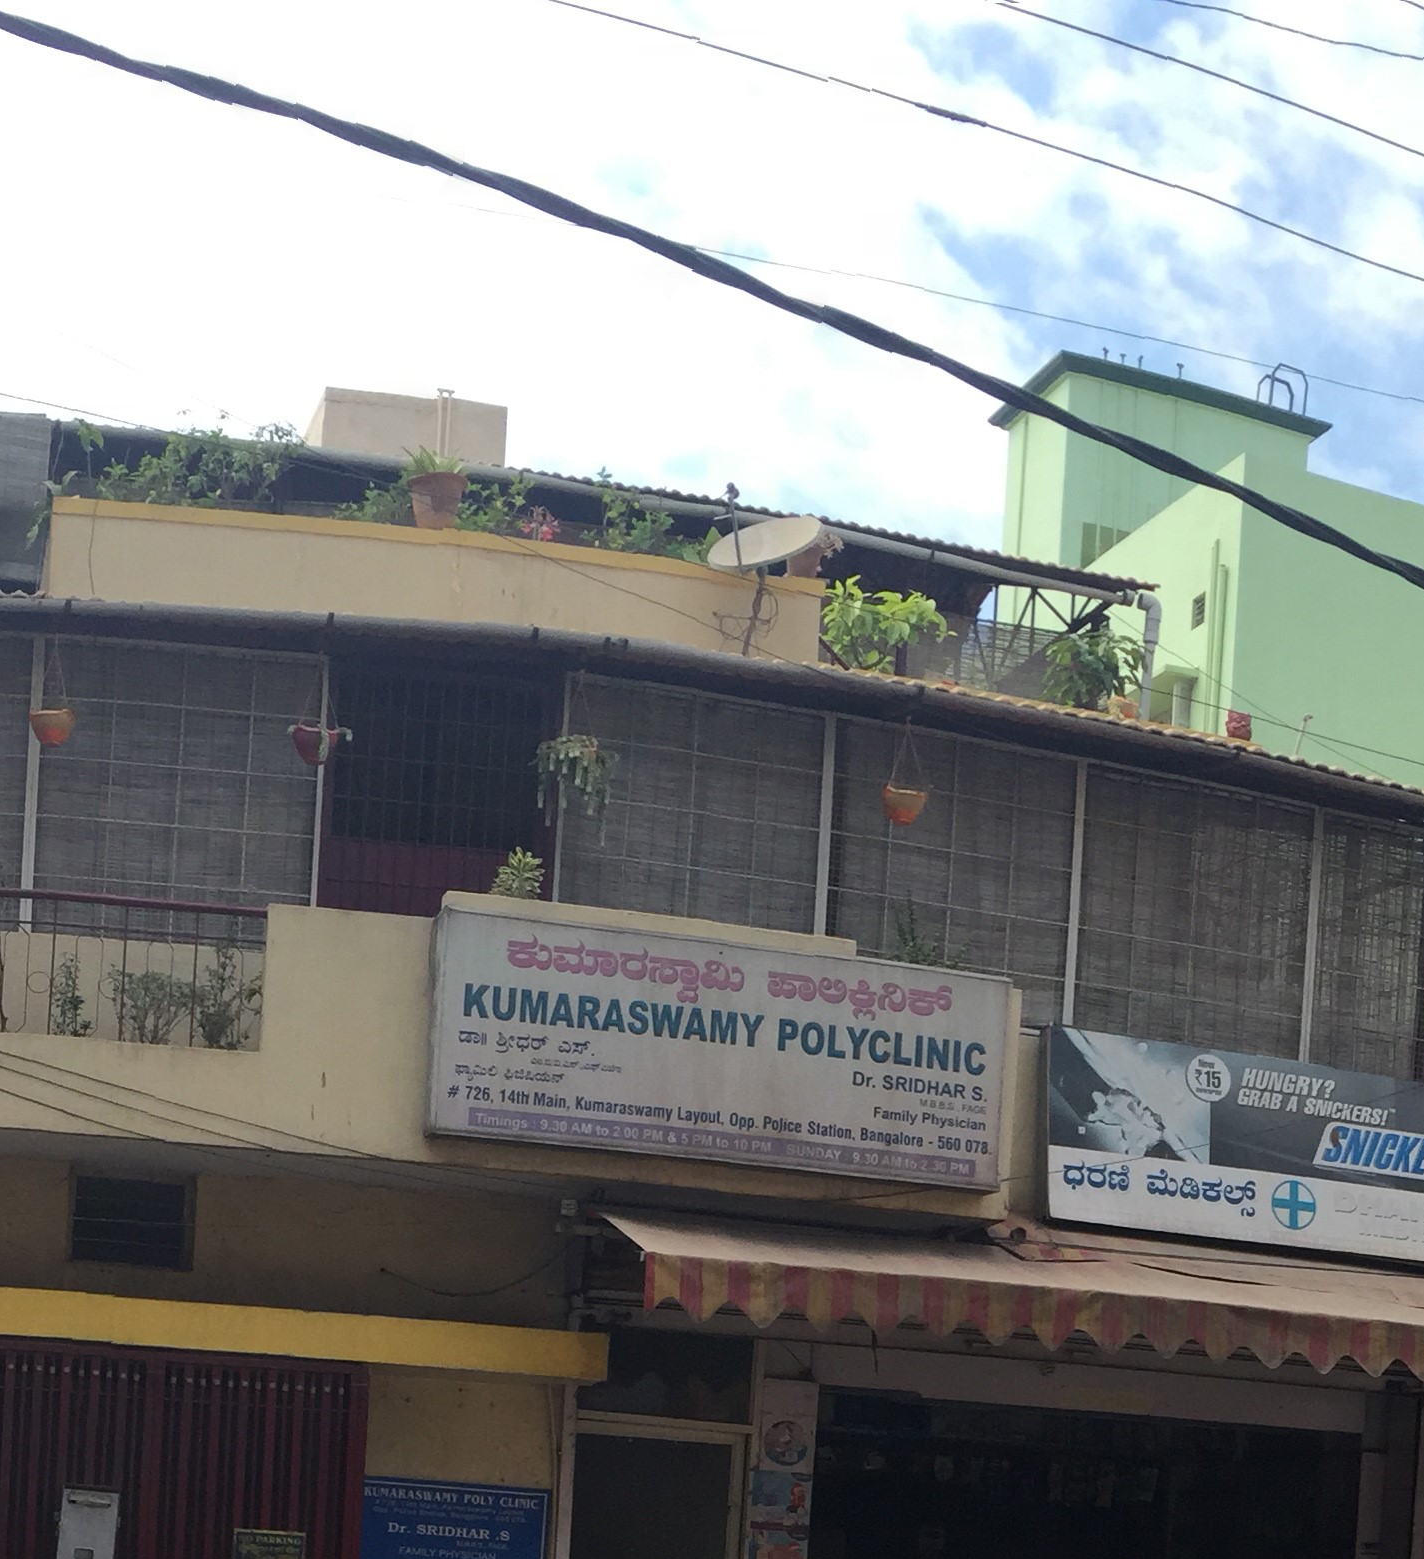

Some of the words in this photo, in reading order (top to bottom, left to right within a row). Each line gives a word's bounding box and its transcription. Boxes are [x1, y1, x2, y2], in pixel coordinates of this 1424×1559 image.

[507, 934, 745, 1003] ಕುಮಾರಸ್ವಾಮಿ
[463, 983, 765, 1048] KUMARASWAMY
[777, 1018, 987, 1076] POLYCLINIC
[852, 1071, 876, 1089] Dr.
[882, 1075, 966, 1099] SRIDHAR
[972, 1086, 988, 1103] S.
[1241, 1067, 1336, 1099] HUNGRY?
[1237, 1088, 1283, 1110] GRAB
[1286, 1098, 1297, 1113] A
[465, 1086, 494, 1103] 726,
[500, 1090, 530, 1105] 14th
[533, 1092, 571, 1111] Main,
[575, 1096, 673, 1122] Kumaraswamy
[677, 1107, 725, 1126] Layout,
[729, 1112, 759, 1131] Opp.
[763, 1116, 803, 1134] Police
[807, 1121, 856, 1141] Station,
[860, 1127, 923, 1147] Bangalore
[938, 1136, 961, 1151] 560
[873, 1107, 918, 1126] Family
[922, 1112, 986, 1132] Physician
[475, 1112, 528, 1131] Timings
[540, 1119, 568, 1132] 9.30
[571, 1122, 592, 1134] AM
[596, 1125, 609, 1137] to
[643, 1129, 664, 1142] PM
[667, 1130, 677, 1144] &
[681, 1132, 689, 1145] 5
[692, 1134, 712, 1147] PM
[715, 1135, 729, 1148] to
[733, 1138, 748, 1150] 10
[752, 1140, 771, 1152] PM
[786, 1143, 841, 1160] SUNDAY
[881, 1155, 902, 1168] AM
[904, 1157, 918, 1170] to
[950, 1162, 969, 1176] PM
[1063, 1161, 1130, 1192] ಧರಣಿ
[364, 1487, 458, 1504] KUMARASWAMY
[463, 1494, 495, 1506] POLY
[499, 1497, 539, 1510] CLINIC
[387, 1522, 411, 1534] Dr.
[416, 1524, 490, 1540] SRIDHAR
[399, 1547, 436, 1558] FAMILY
